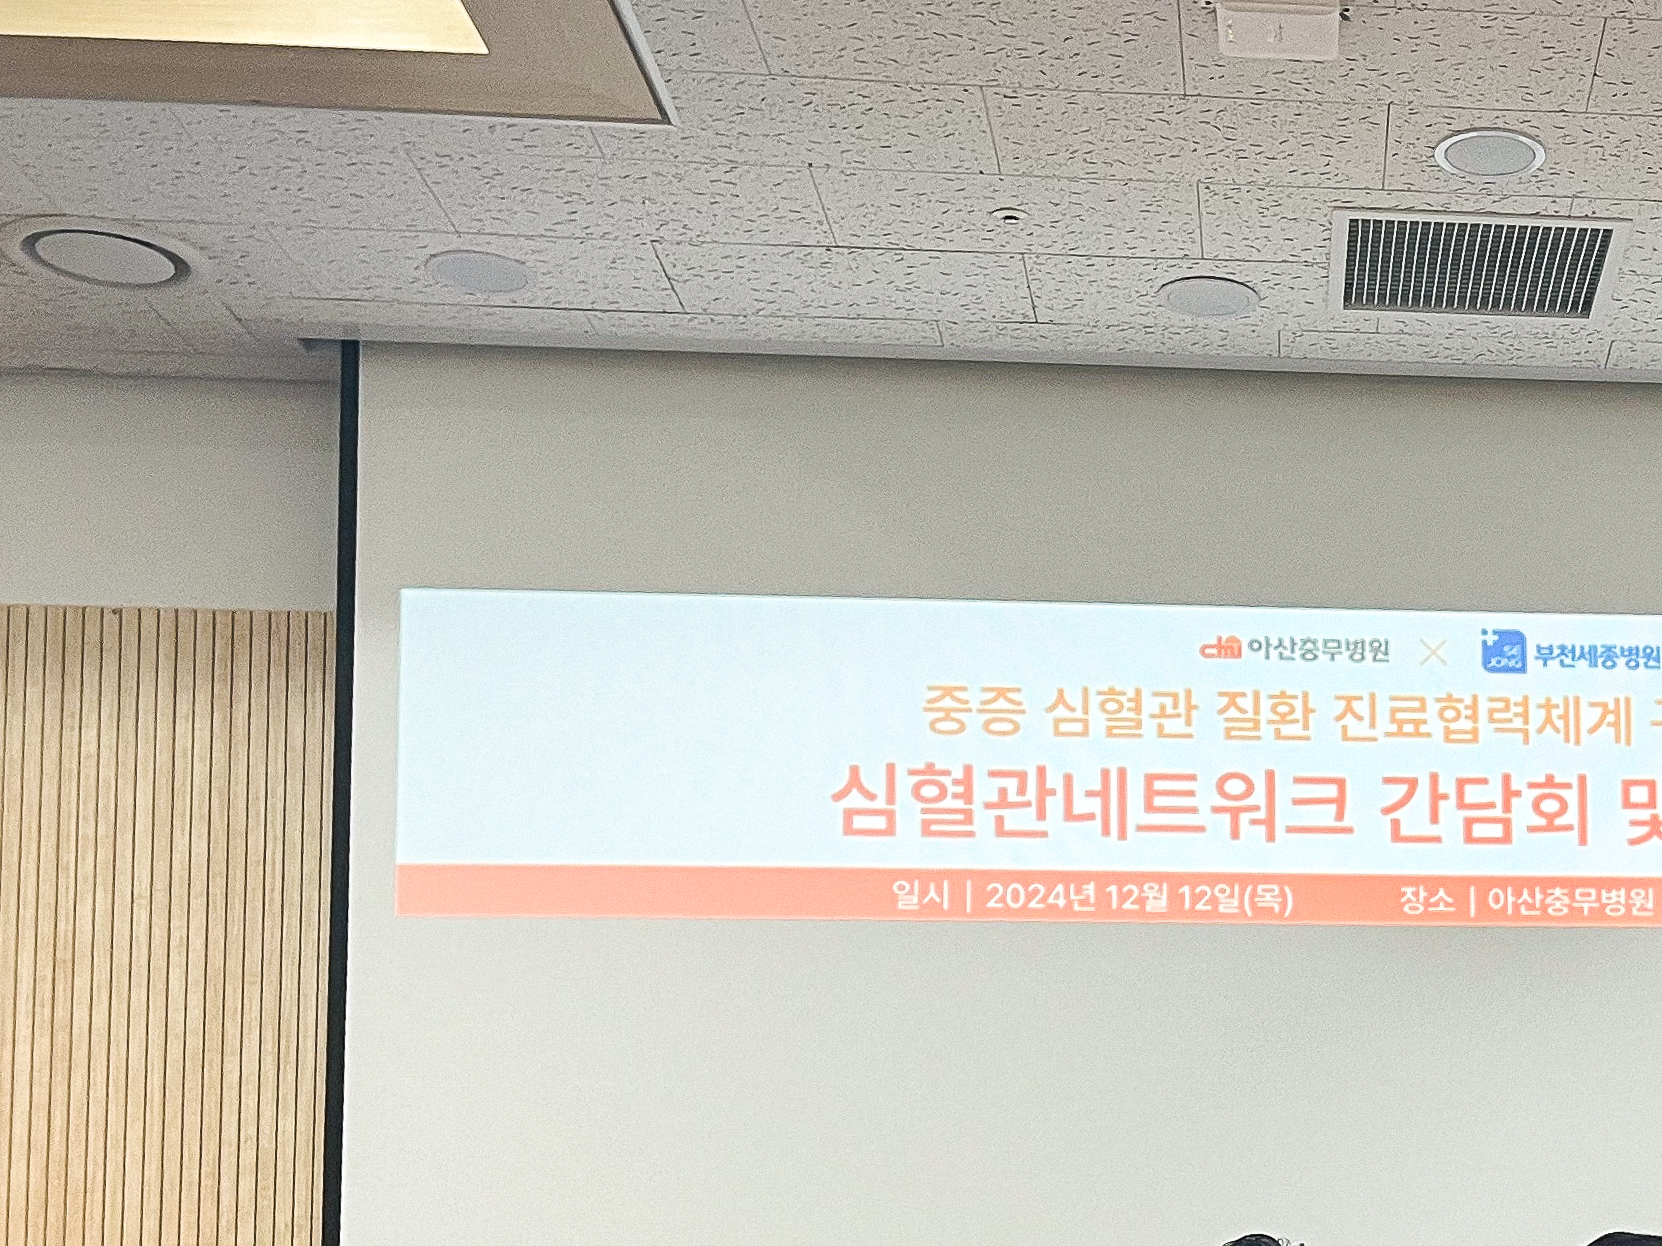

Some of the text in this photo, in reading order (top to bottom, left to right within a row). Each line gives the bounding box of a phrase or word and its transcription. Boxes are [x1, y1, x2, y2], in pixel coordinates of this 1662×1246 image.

[1248, 636, 1390, 663] 아산충무병원
[1534, 643, 1661, 670] 부천세종병원
[922, 684, 1027, 737] 중증
[1045, 685, 1199, 740] 심혈관
[1217, 689, 1316, 742] 질환
[1334, 691, 1633, 748] 진료협력체계
[830, 762, 1356, 843] 심혈관네트워크
[1381, 771, 1589, 846] 간담회
[892, 879, 1294, 917] 일시 2024년 12월 12일(목)
[1400, 885, 1456, 914] 장소
[1488, 886, 1654, 917] 아산충무병원
